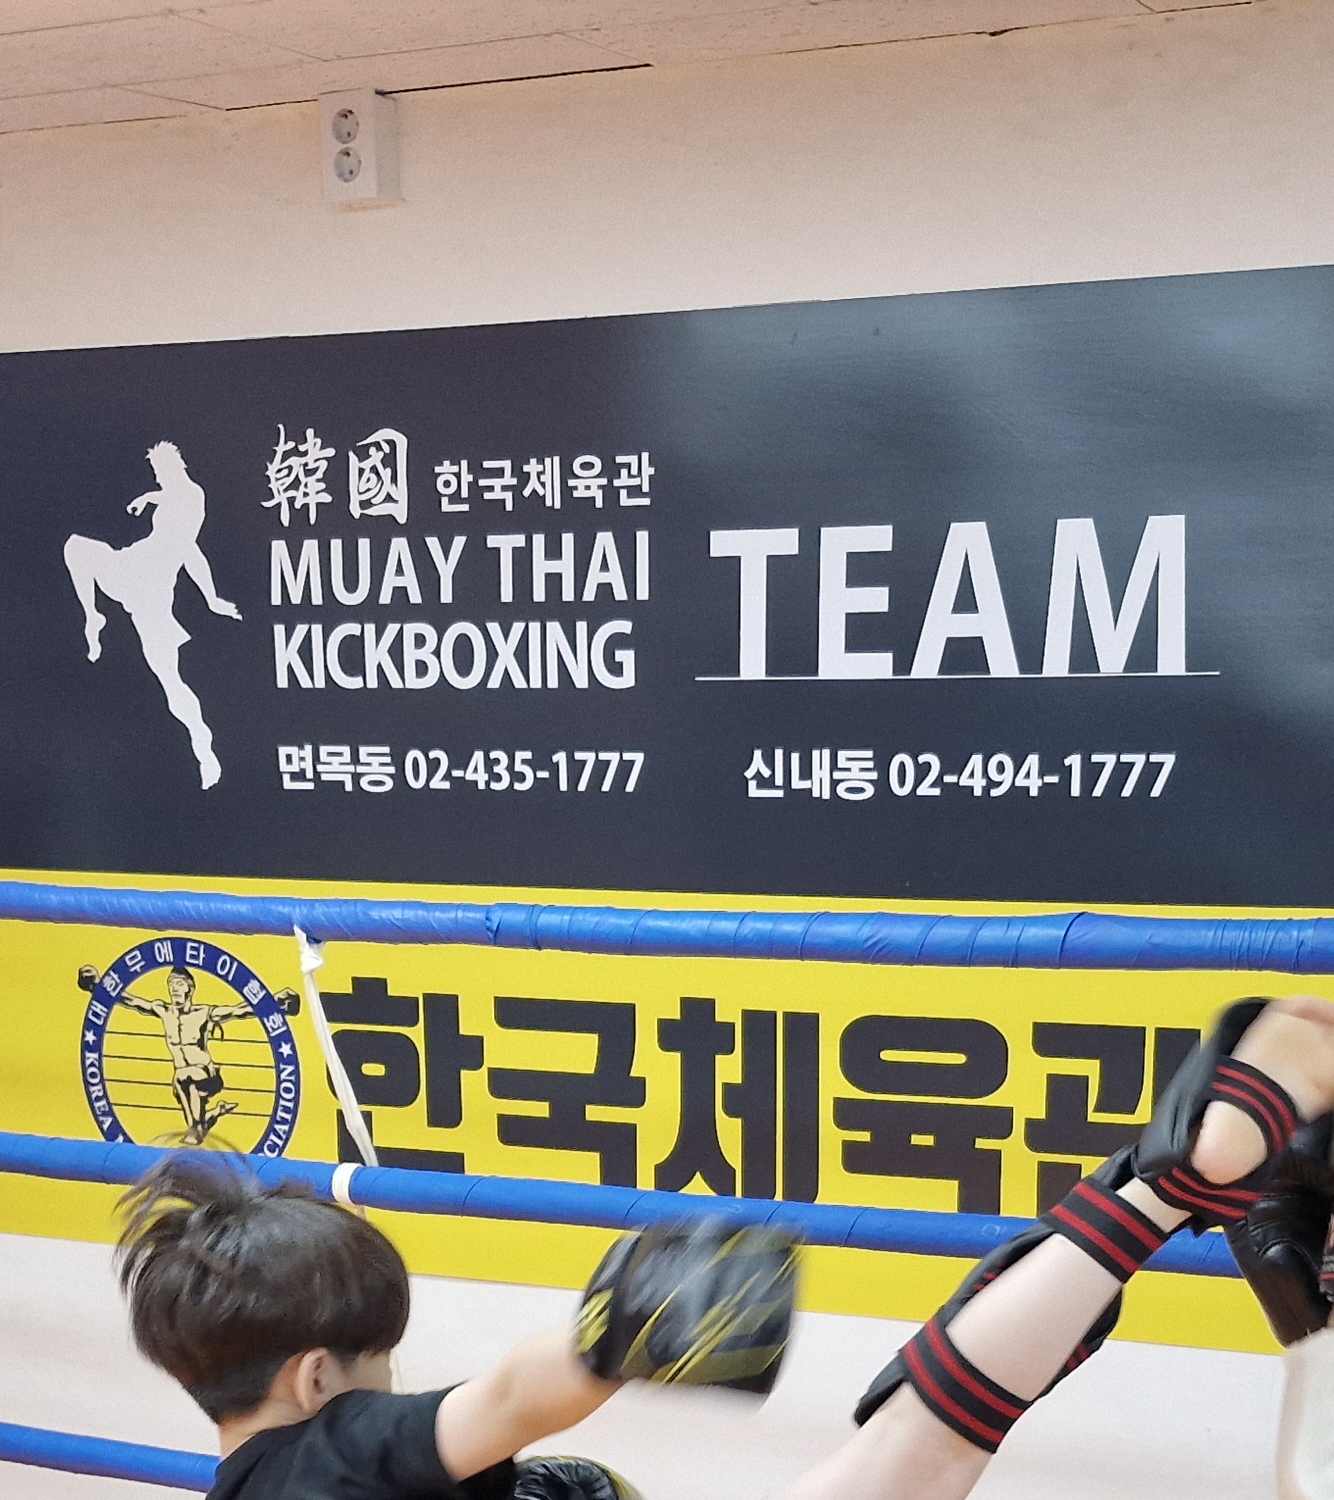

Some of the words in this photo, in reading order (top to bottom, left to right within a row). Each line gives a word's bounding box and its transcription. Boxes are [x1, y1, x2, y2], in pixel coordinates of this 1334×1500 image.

[261, 424, 409, 527] 韓國
[434, 452, 656, 512] 한국체육관
[270, 535, 468, 606] MUAY
[487, 531, 649, 602] THAI
[709, 514, 1187, 678] TEAM
[274, 621, 637, 690] KICKBOXING
[277, 744, 396, 793] 면목동
[404, 749, 646, 793] 02-435-1777
[743, 747, 878, 801] 신내동
[888, 753, 1176, 798] 02-494-1777
[85, 1051, 114, 1132] KOREA
[258, 1063, 296, 1158] CIATION
